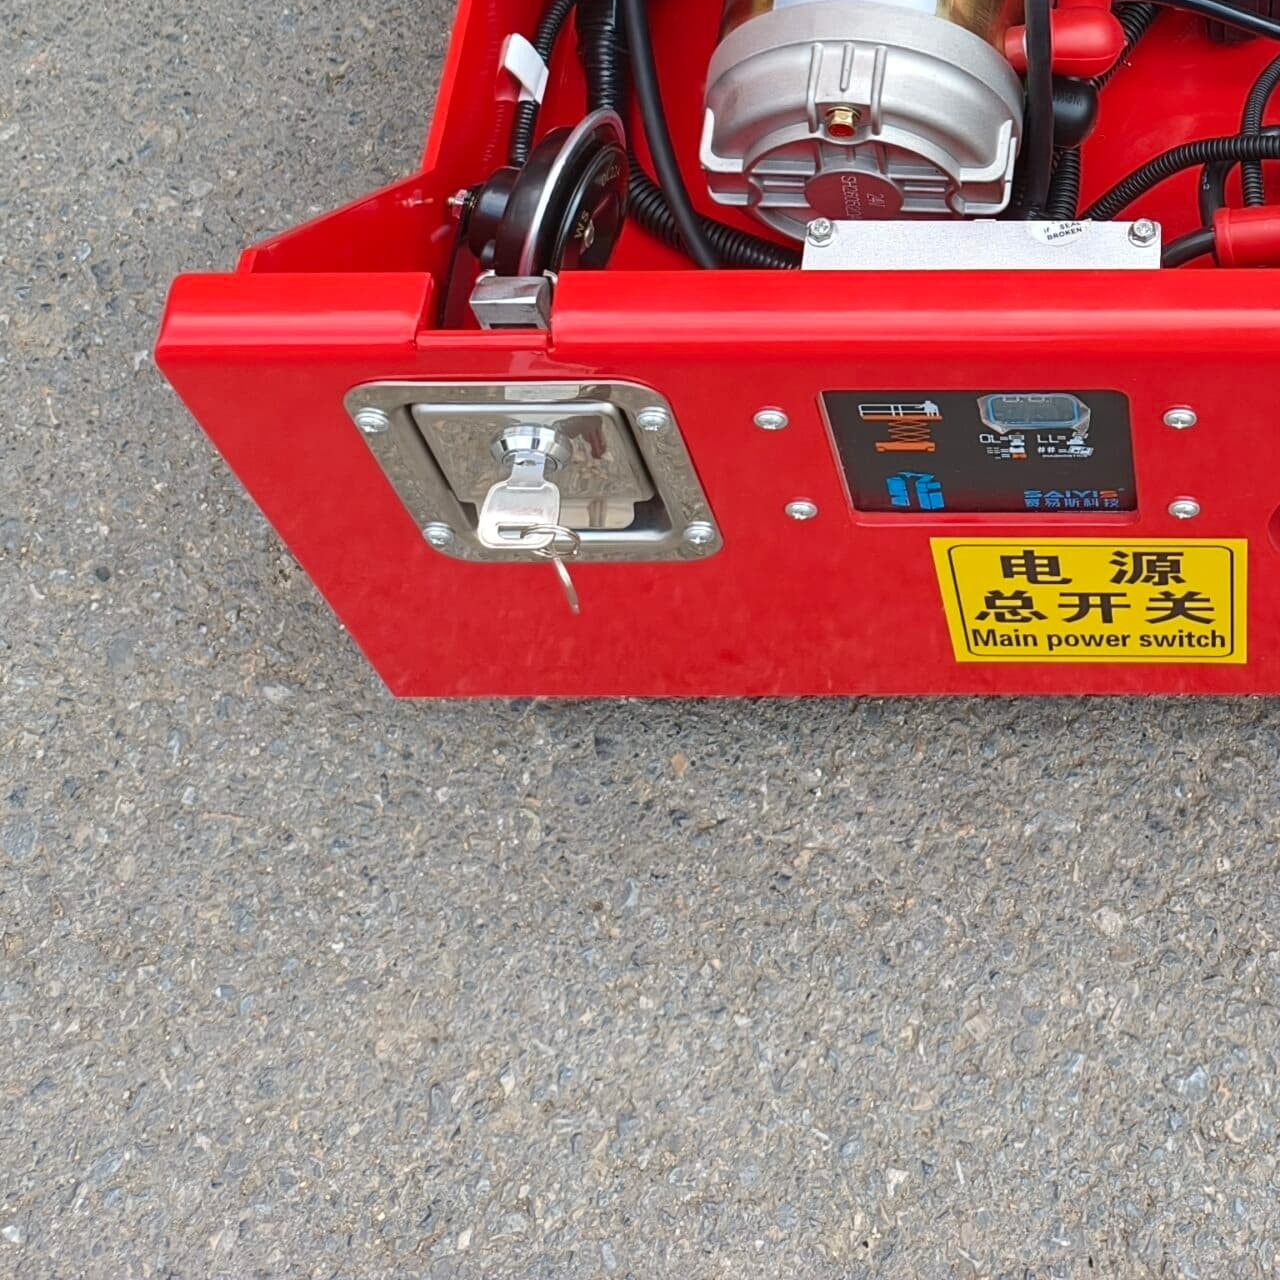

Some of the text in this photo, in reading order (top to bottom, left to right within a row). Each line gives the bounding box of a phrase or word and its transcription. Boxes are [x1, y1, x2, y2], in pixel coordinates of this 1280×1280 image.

[1046, 226, 1083, 241] BROKEN
[974, 589, 1217, 625] 总开关
[971, 627, 1227, 652] Main power switch
